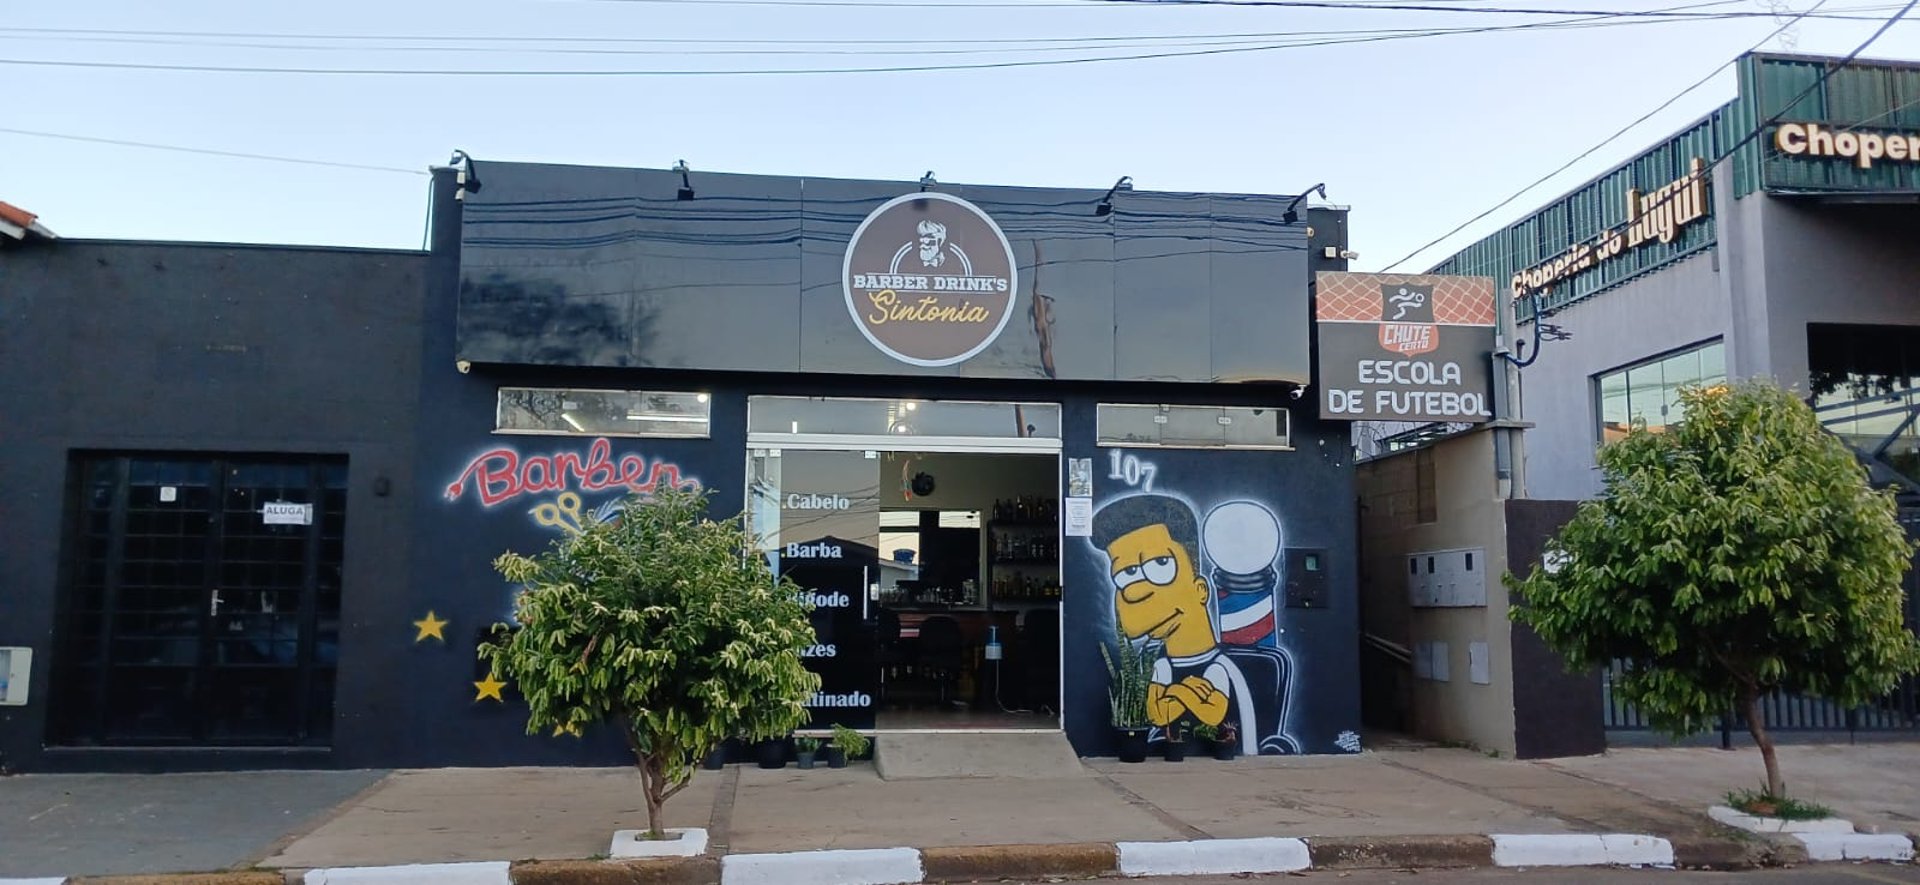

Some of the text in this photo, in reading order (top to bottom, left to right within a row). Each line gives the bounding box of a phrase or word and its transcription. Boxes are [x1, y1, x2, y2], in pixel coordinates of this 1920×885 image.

[854, 275, 1007, 292] BARBER DRINK'S
[868, 289, 989, 324] Sintonia
[1384, 325, 1432, 345] CHUTE
[1358, 360, 1461, 385] ESCOLA
[1328, 389, 1492, 417] DE FUTEBOL
[1108, 449, 1158, 493] 107
[266, 506, 304, 515] ALUGA
